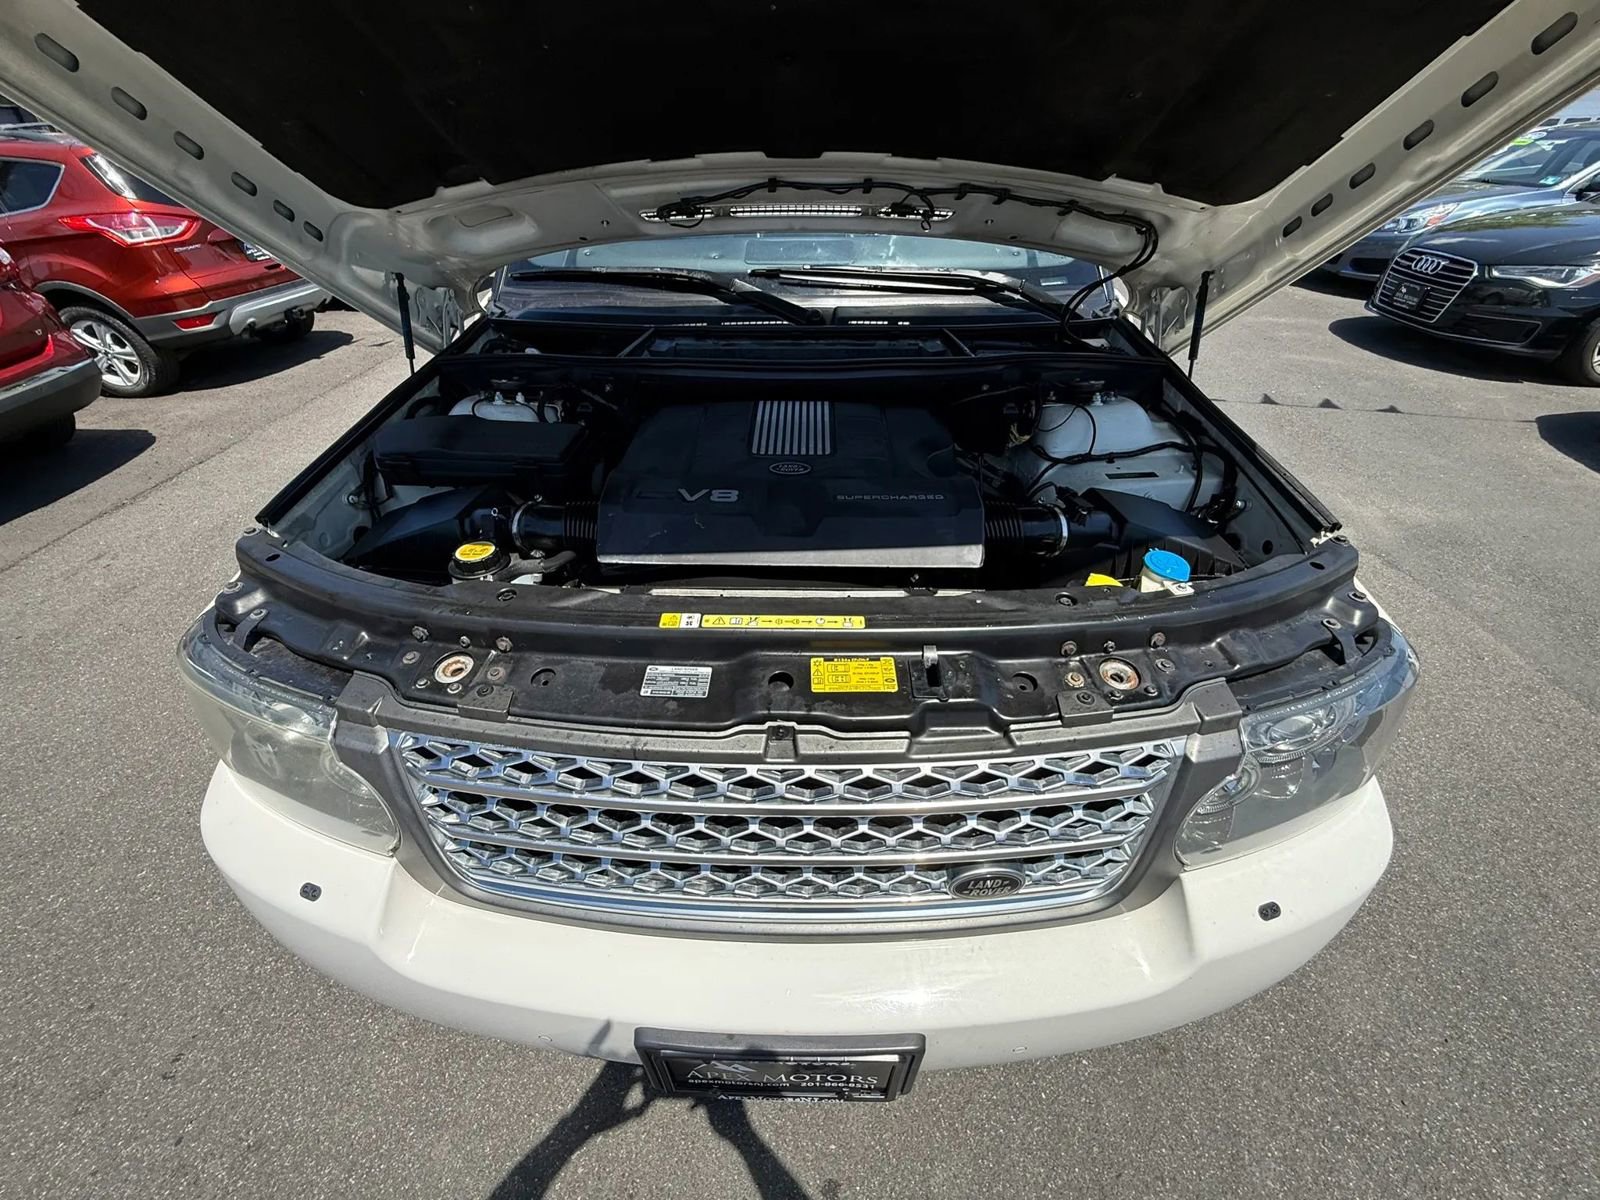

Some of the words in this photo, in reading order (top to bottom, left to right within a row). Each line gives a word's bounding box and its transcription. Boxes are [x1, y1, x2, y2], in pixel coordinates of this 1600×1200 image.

[678, 488, 739, 502] V8
[968, 879, 1002, 889] LAND
[970, 886, 1011, 896] ROVER
[687, 1070, 751, 1081] APEX
[763, 1073, 878, 1084] MOTORS
